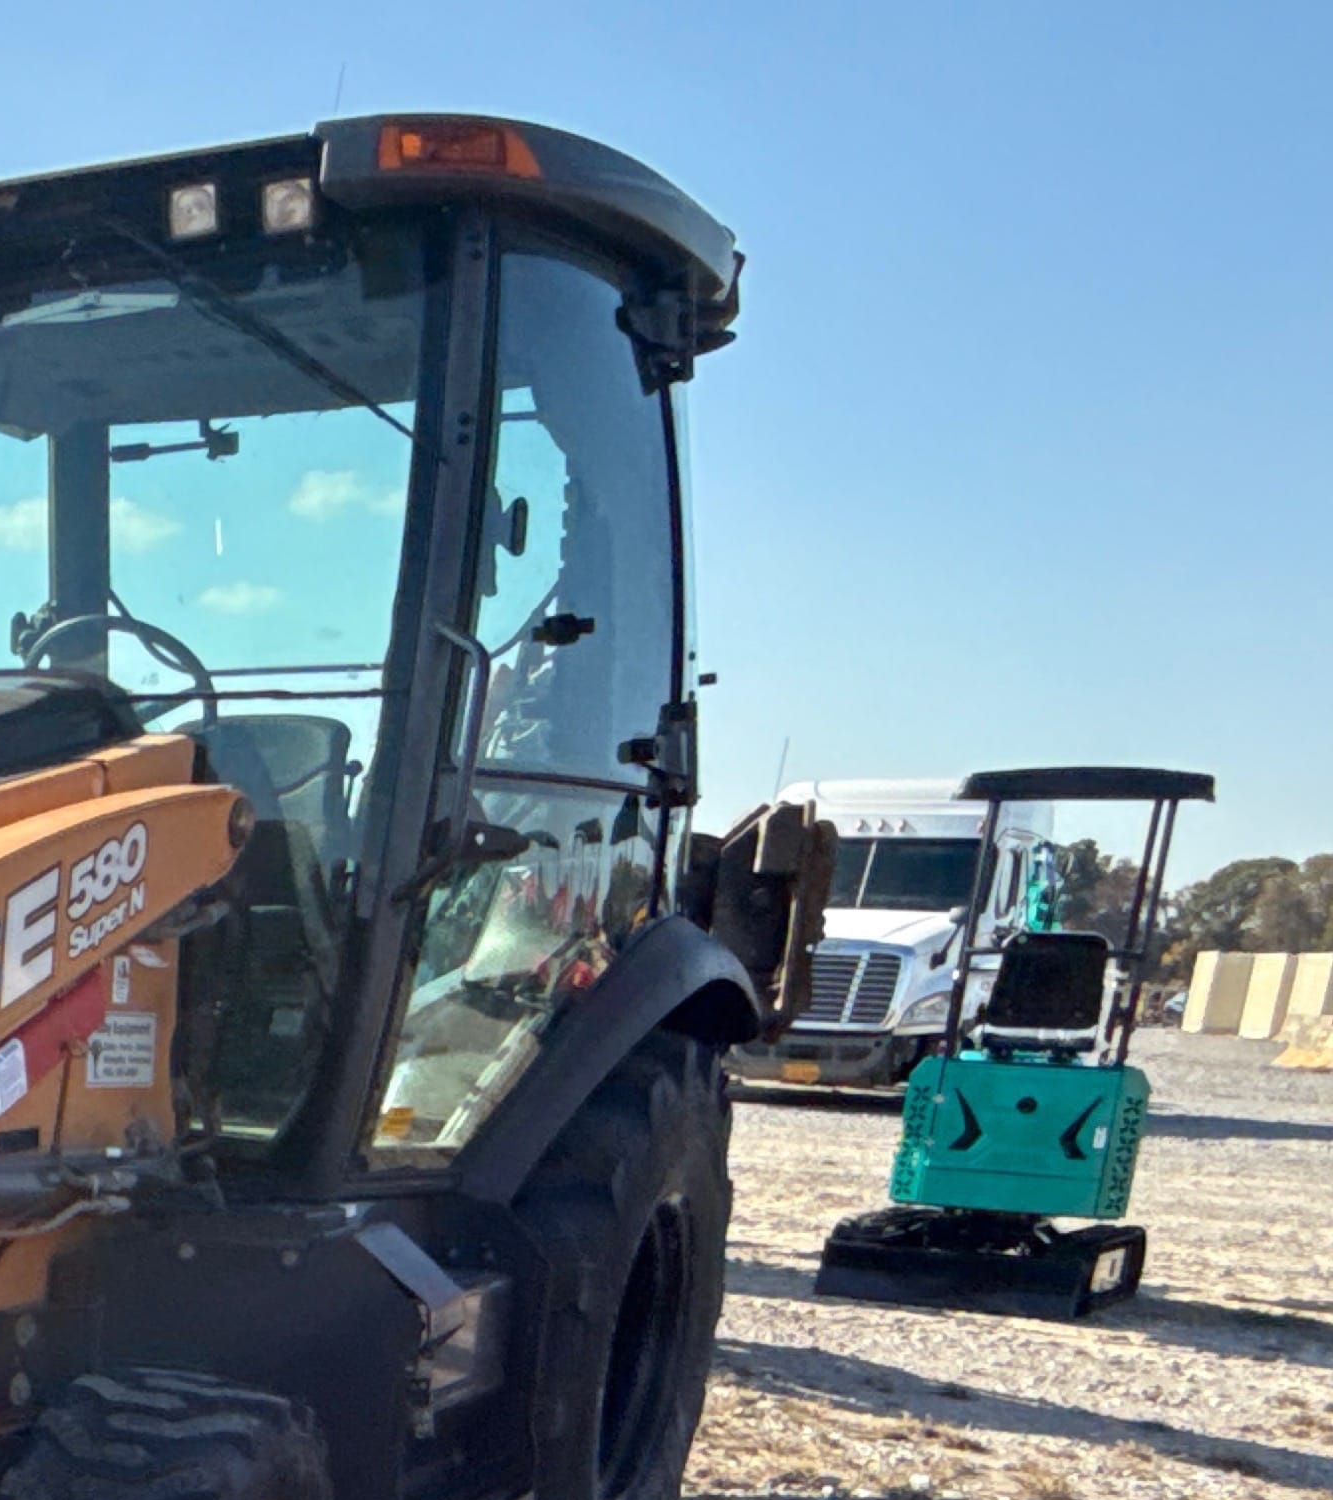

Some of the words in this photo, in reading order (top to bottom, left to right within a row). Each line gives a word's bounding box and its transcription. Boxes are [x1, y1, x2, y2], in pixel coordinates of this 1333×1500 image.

[67, 821, 148, 921] 580
[68, 901, 128, 958] Super
[129, 880, 145, 917] N
